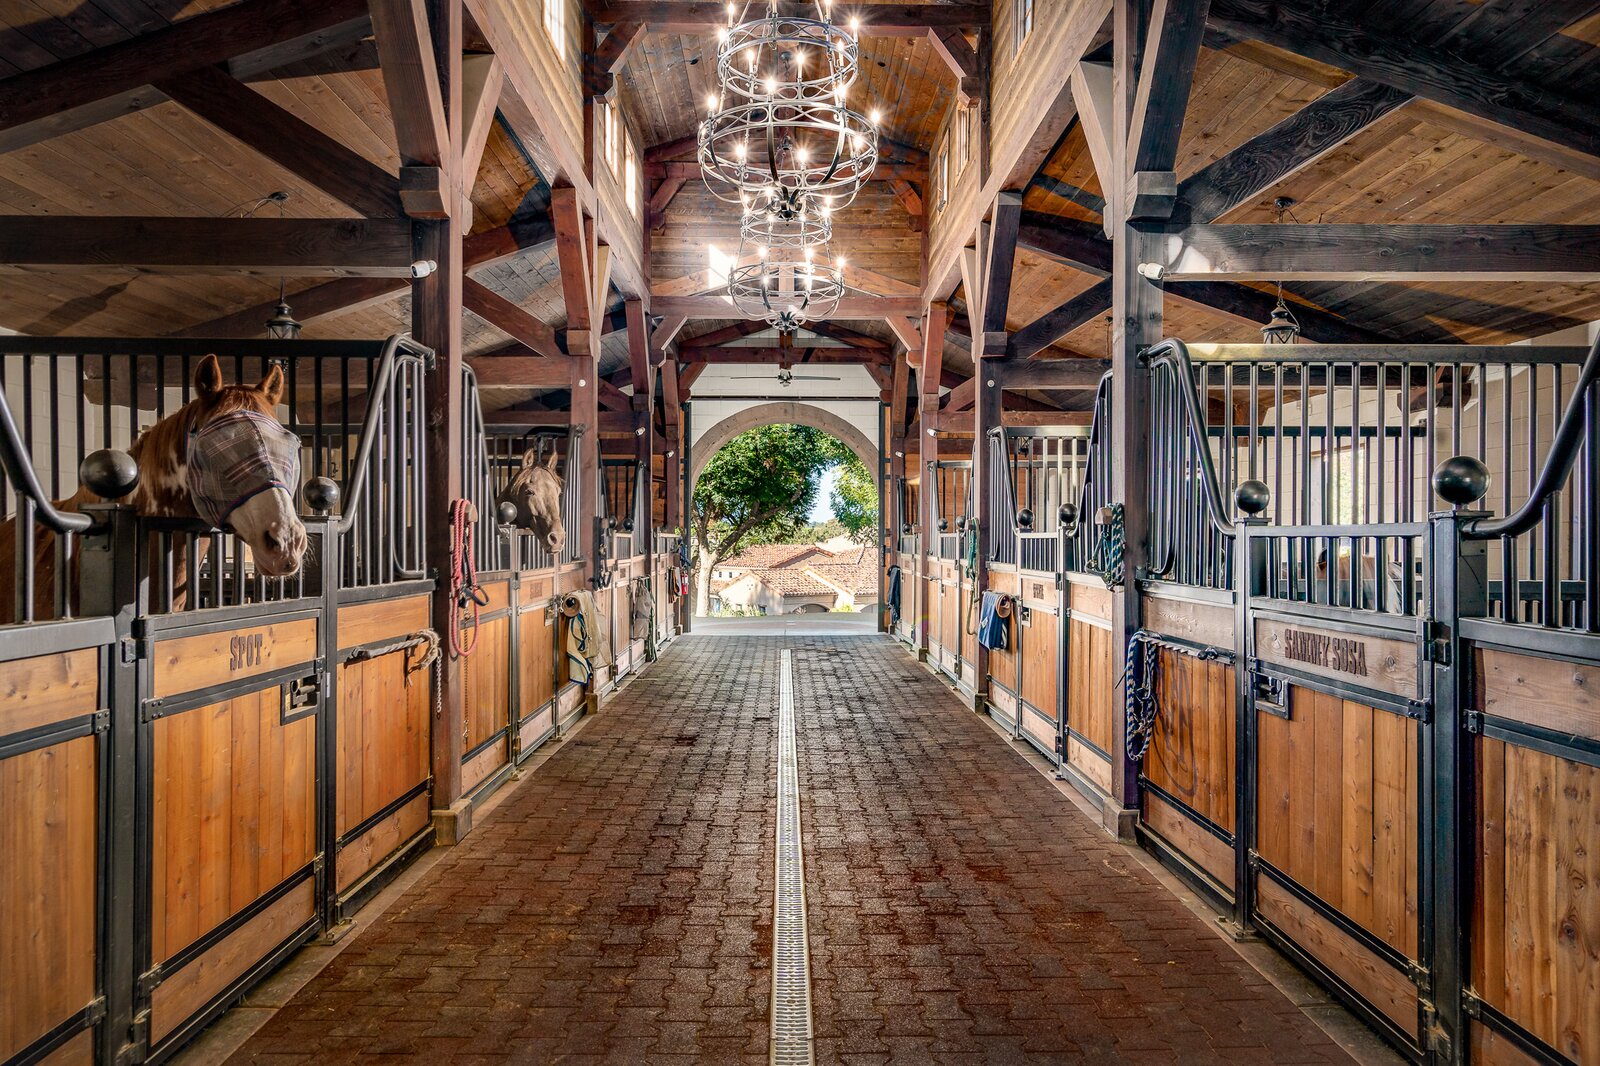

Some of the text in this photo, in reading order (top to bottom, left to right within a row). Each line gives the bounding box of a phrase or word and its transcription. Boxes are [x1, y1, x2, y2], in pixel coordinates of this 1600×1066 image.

[229, 633, 263, 671] SPOT
[1284, 628, 1368, 677] SAMMY SOSA
